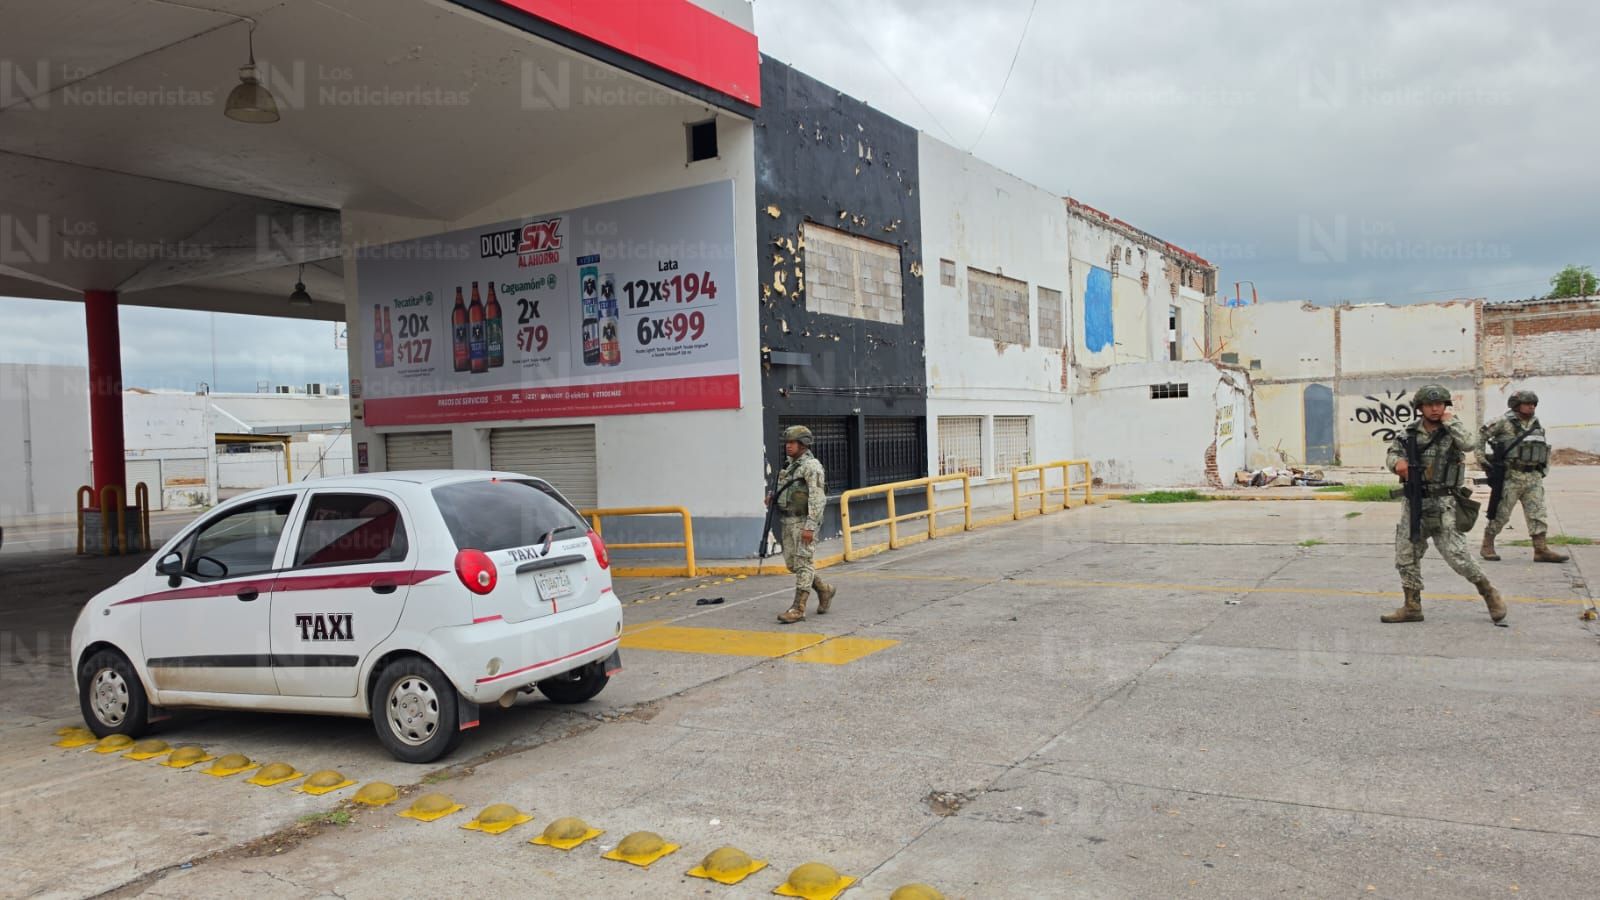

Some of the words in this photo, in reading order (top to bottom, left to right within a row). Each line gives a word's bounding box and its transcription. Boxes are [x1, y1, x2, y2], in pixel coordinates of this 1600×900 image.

[481, 235, 492, 255] DI
[494, 231, 515, 255] QUE
[518, 218, 562, 254] SIX
[518, 255, 527, 268] AL
[528, 252, 559, 267] AHORRO
[658, 260, 678, 272] Lata
[516, 325, 549, 352] $79
[397, 339, 432, 364] $127
[508, 547, 538, 561] TAXI
[295, 613, 354, 641] TAXI
